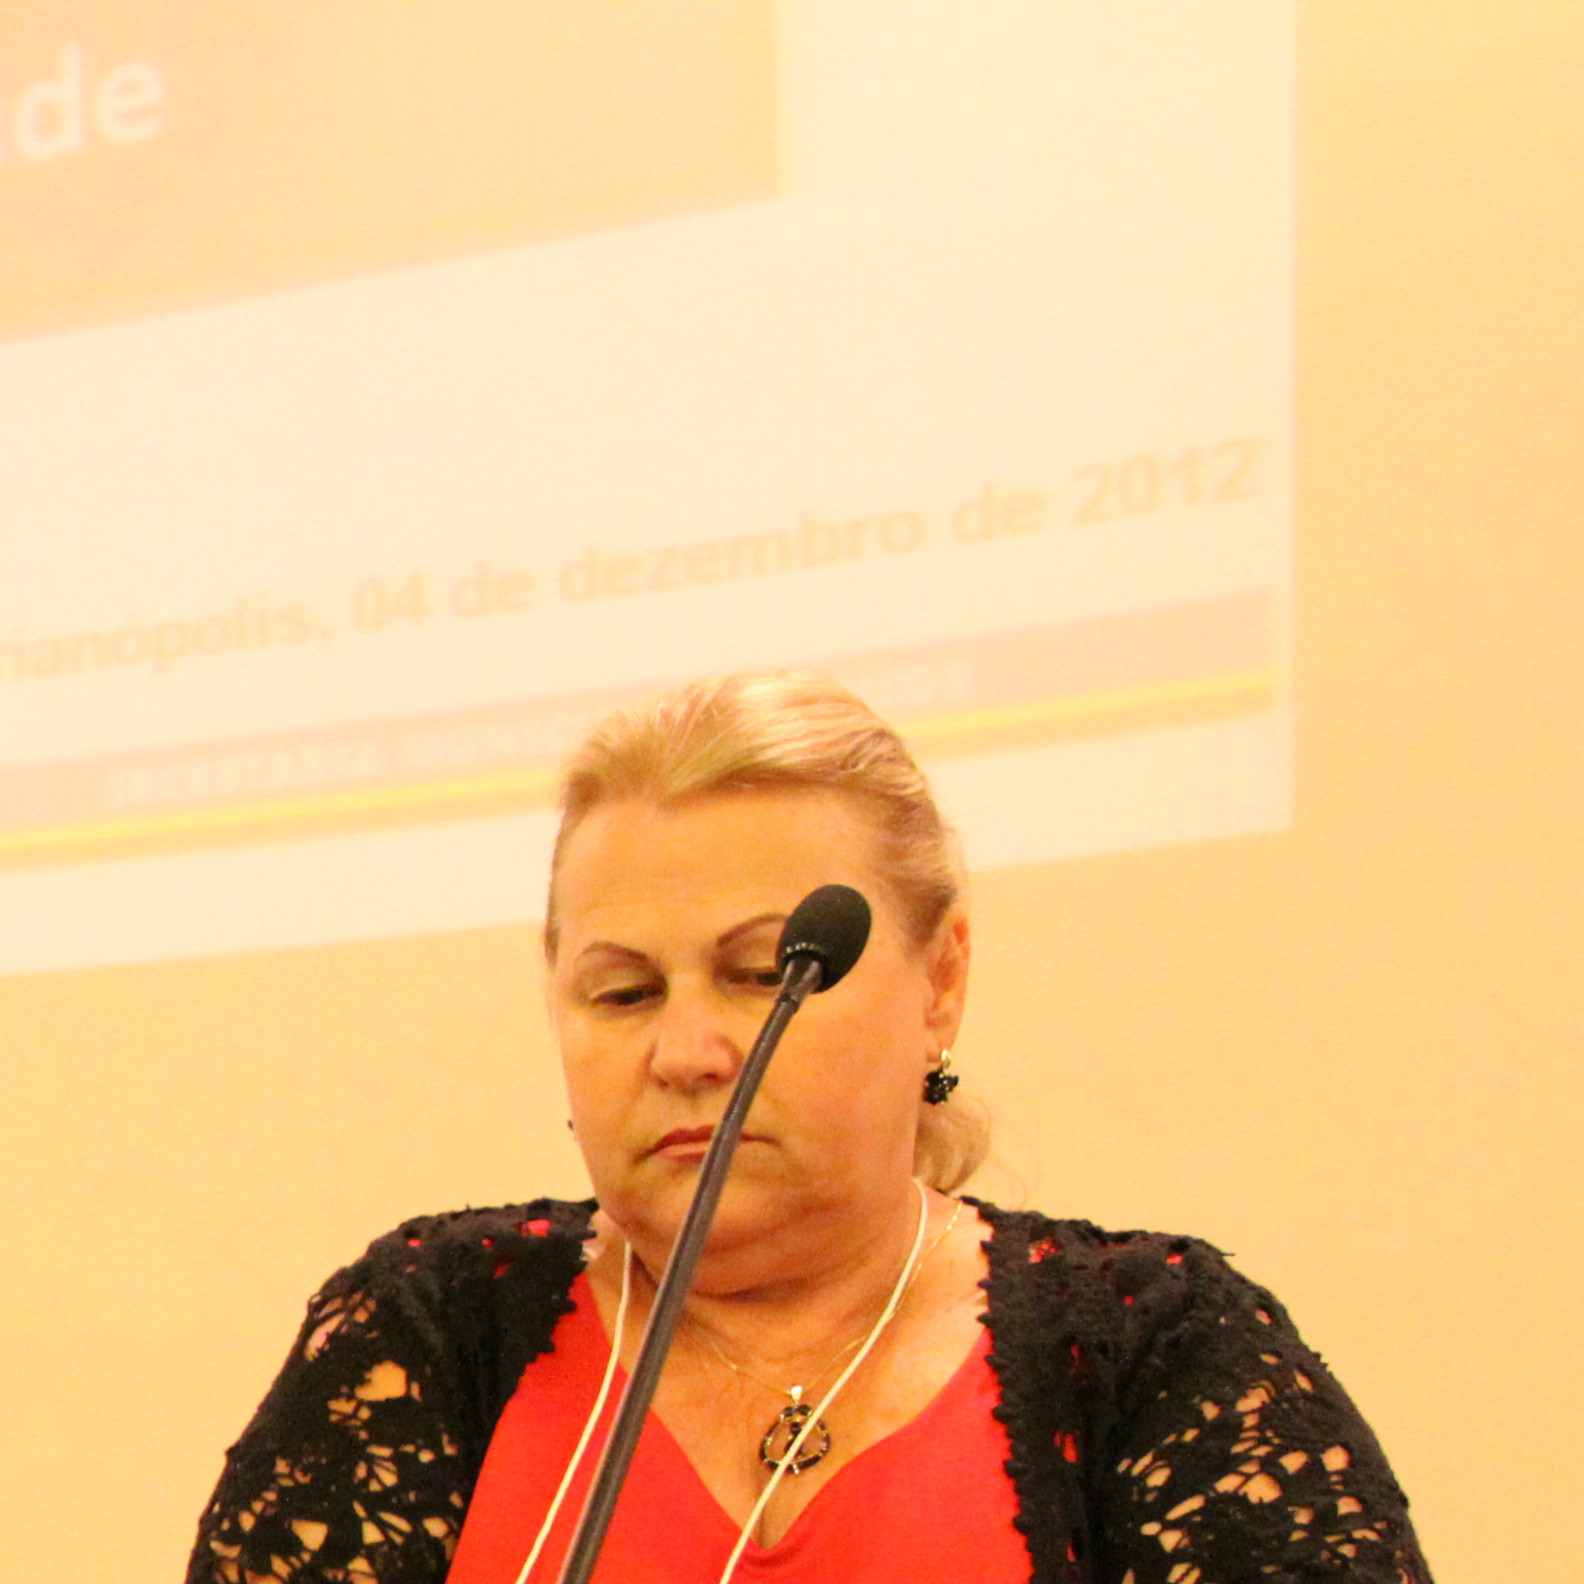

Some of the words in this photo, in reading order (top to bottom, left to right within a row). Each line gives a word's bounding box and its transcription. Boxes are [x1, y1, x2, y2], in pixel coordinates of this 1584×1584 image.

[348, 568, 430, 634] 04
[449, 558, 537, 621] de
[557, 509, 929, 604] dezembro
[950, 479, 1045, 546] de
[1070, 436, 1263, 528] 2012
